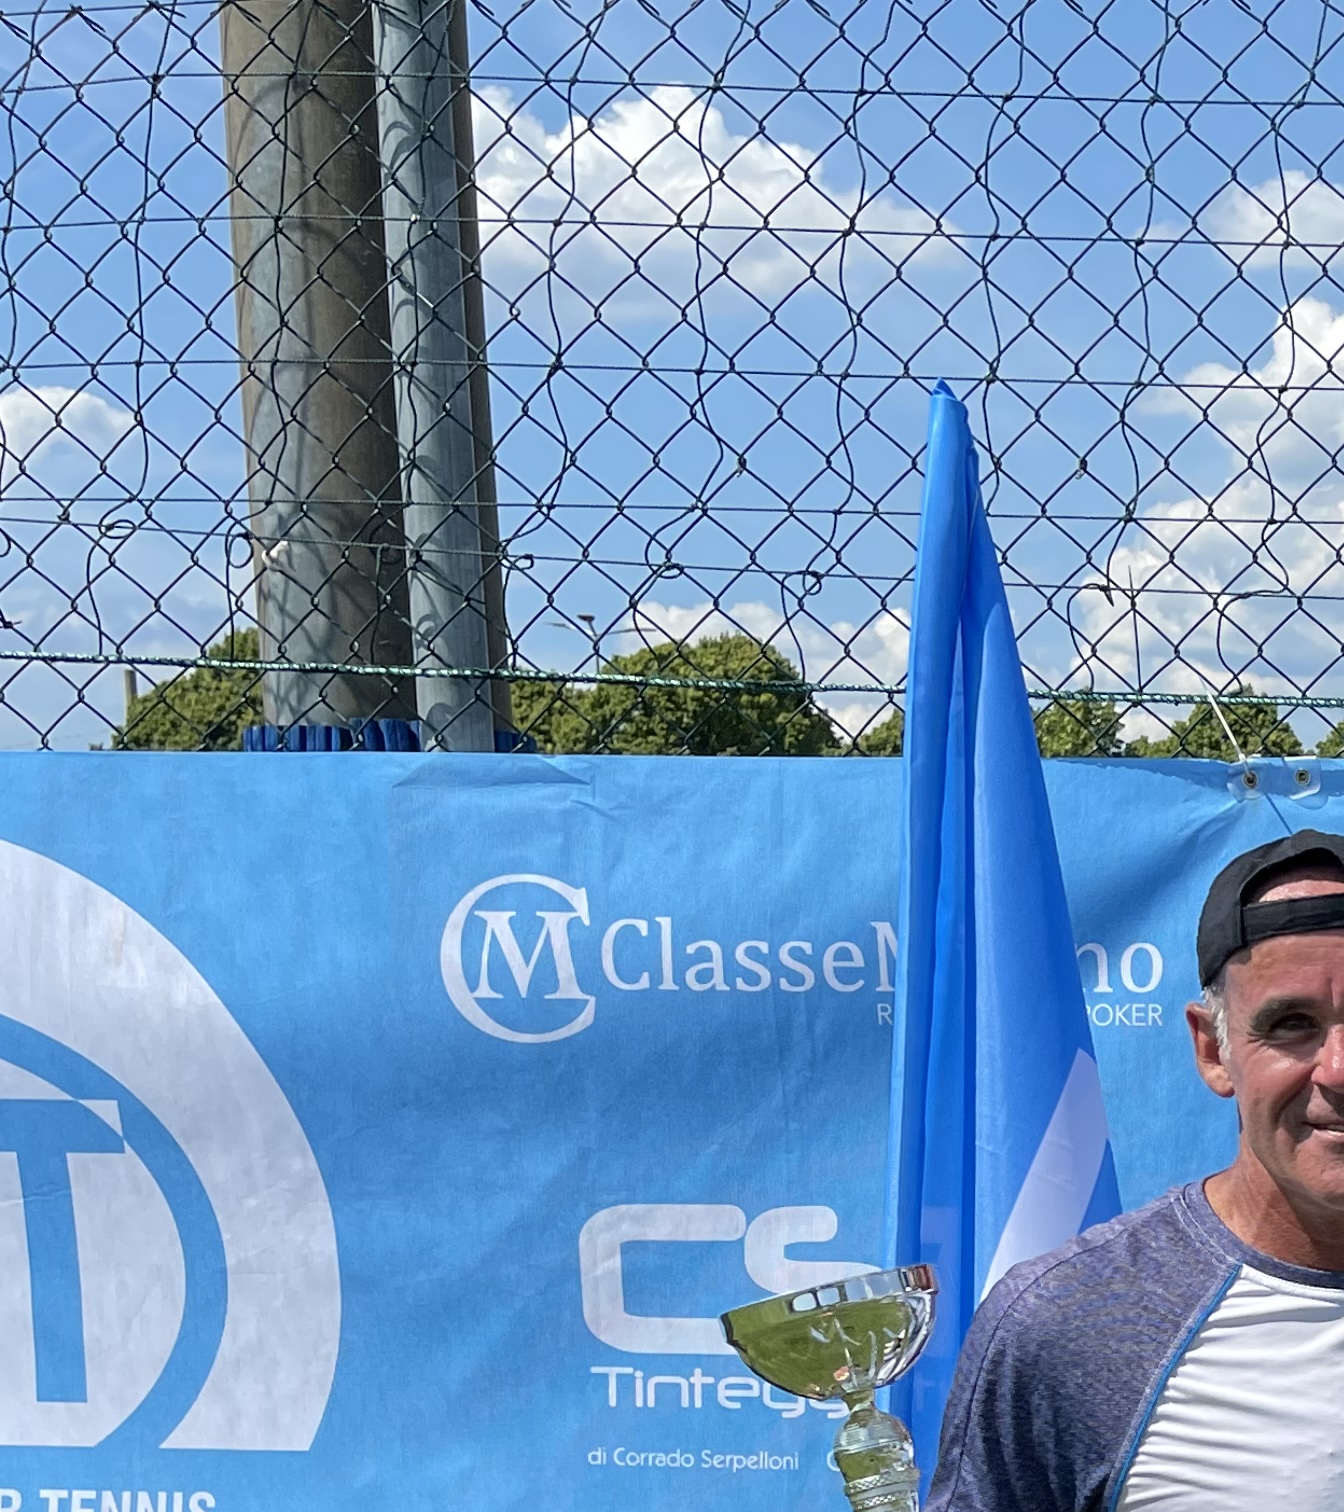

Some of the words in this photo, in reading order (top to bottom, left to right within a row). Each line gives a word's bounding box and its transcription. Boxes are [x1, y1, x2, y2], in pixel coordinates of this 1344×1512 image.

[588, 1446, 607, 1466] di
[613, 1447, 695, 1469] Corrado
[701, 1449, 799, 1473] Serpelloni
